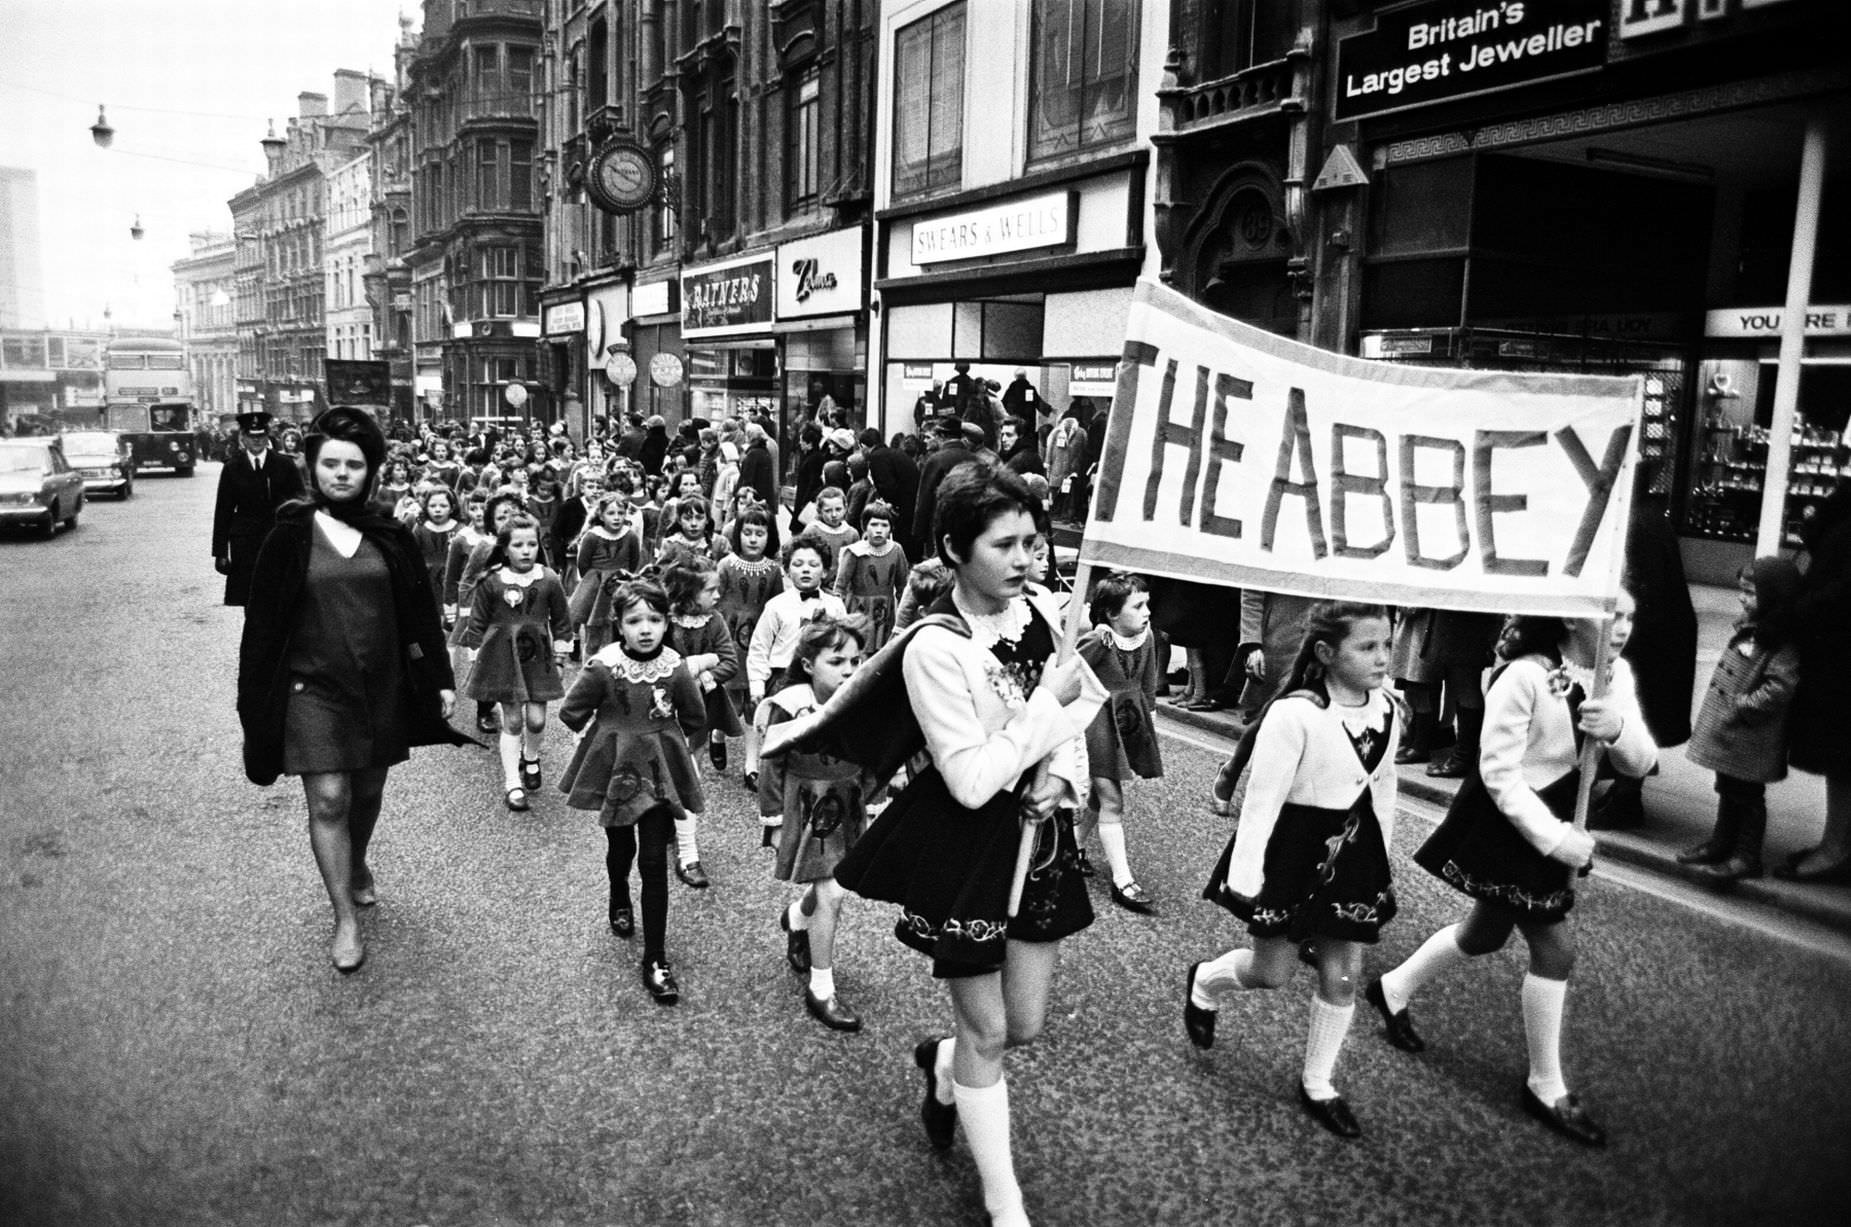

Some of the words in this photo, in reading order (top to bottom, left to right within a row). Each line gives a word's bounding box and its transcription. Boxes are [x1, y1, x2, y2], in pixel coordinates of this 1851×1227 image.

[1408, 2, 1525, 50] Britain's
[1346, 53, 1450, 97] Largest
[1459, 19, 1602, 71] Jeweller
[918, 222, 978, 254] SWEARS
[1000, 207, 1059, 240] WELLS
[692, 274, 760, 311] RATNERS
[1740, 314, 1780, 329] YOU
[1805, 312, 1837, 328] RE
[1095, 340, 1254, 539] THE
[1261, 387, 1634, 577] ABBEY
